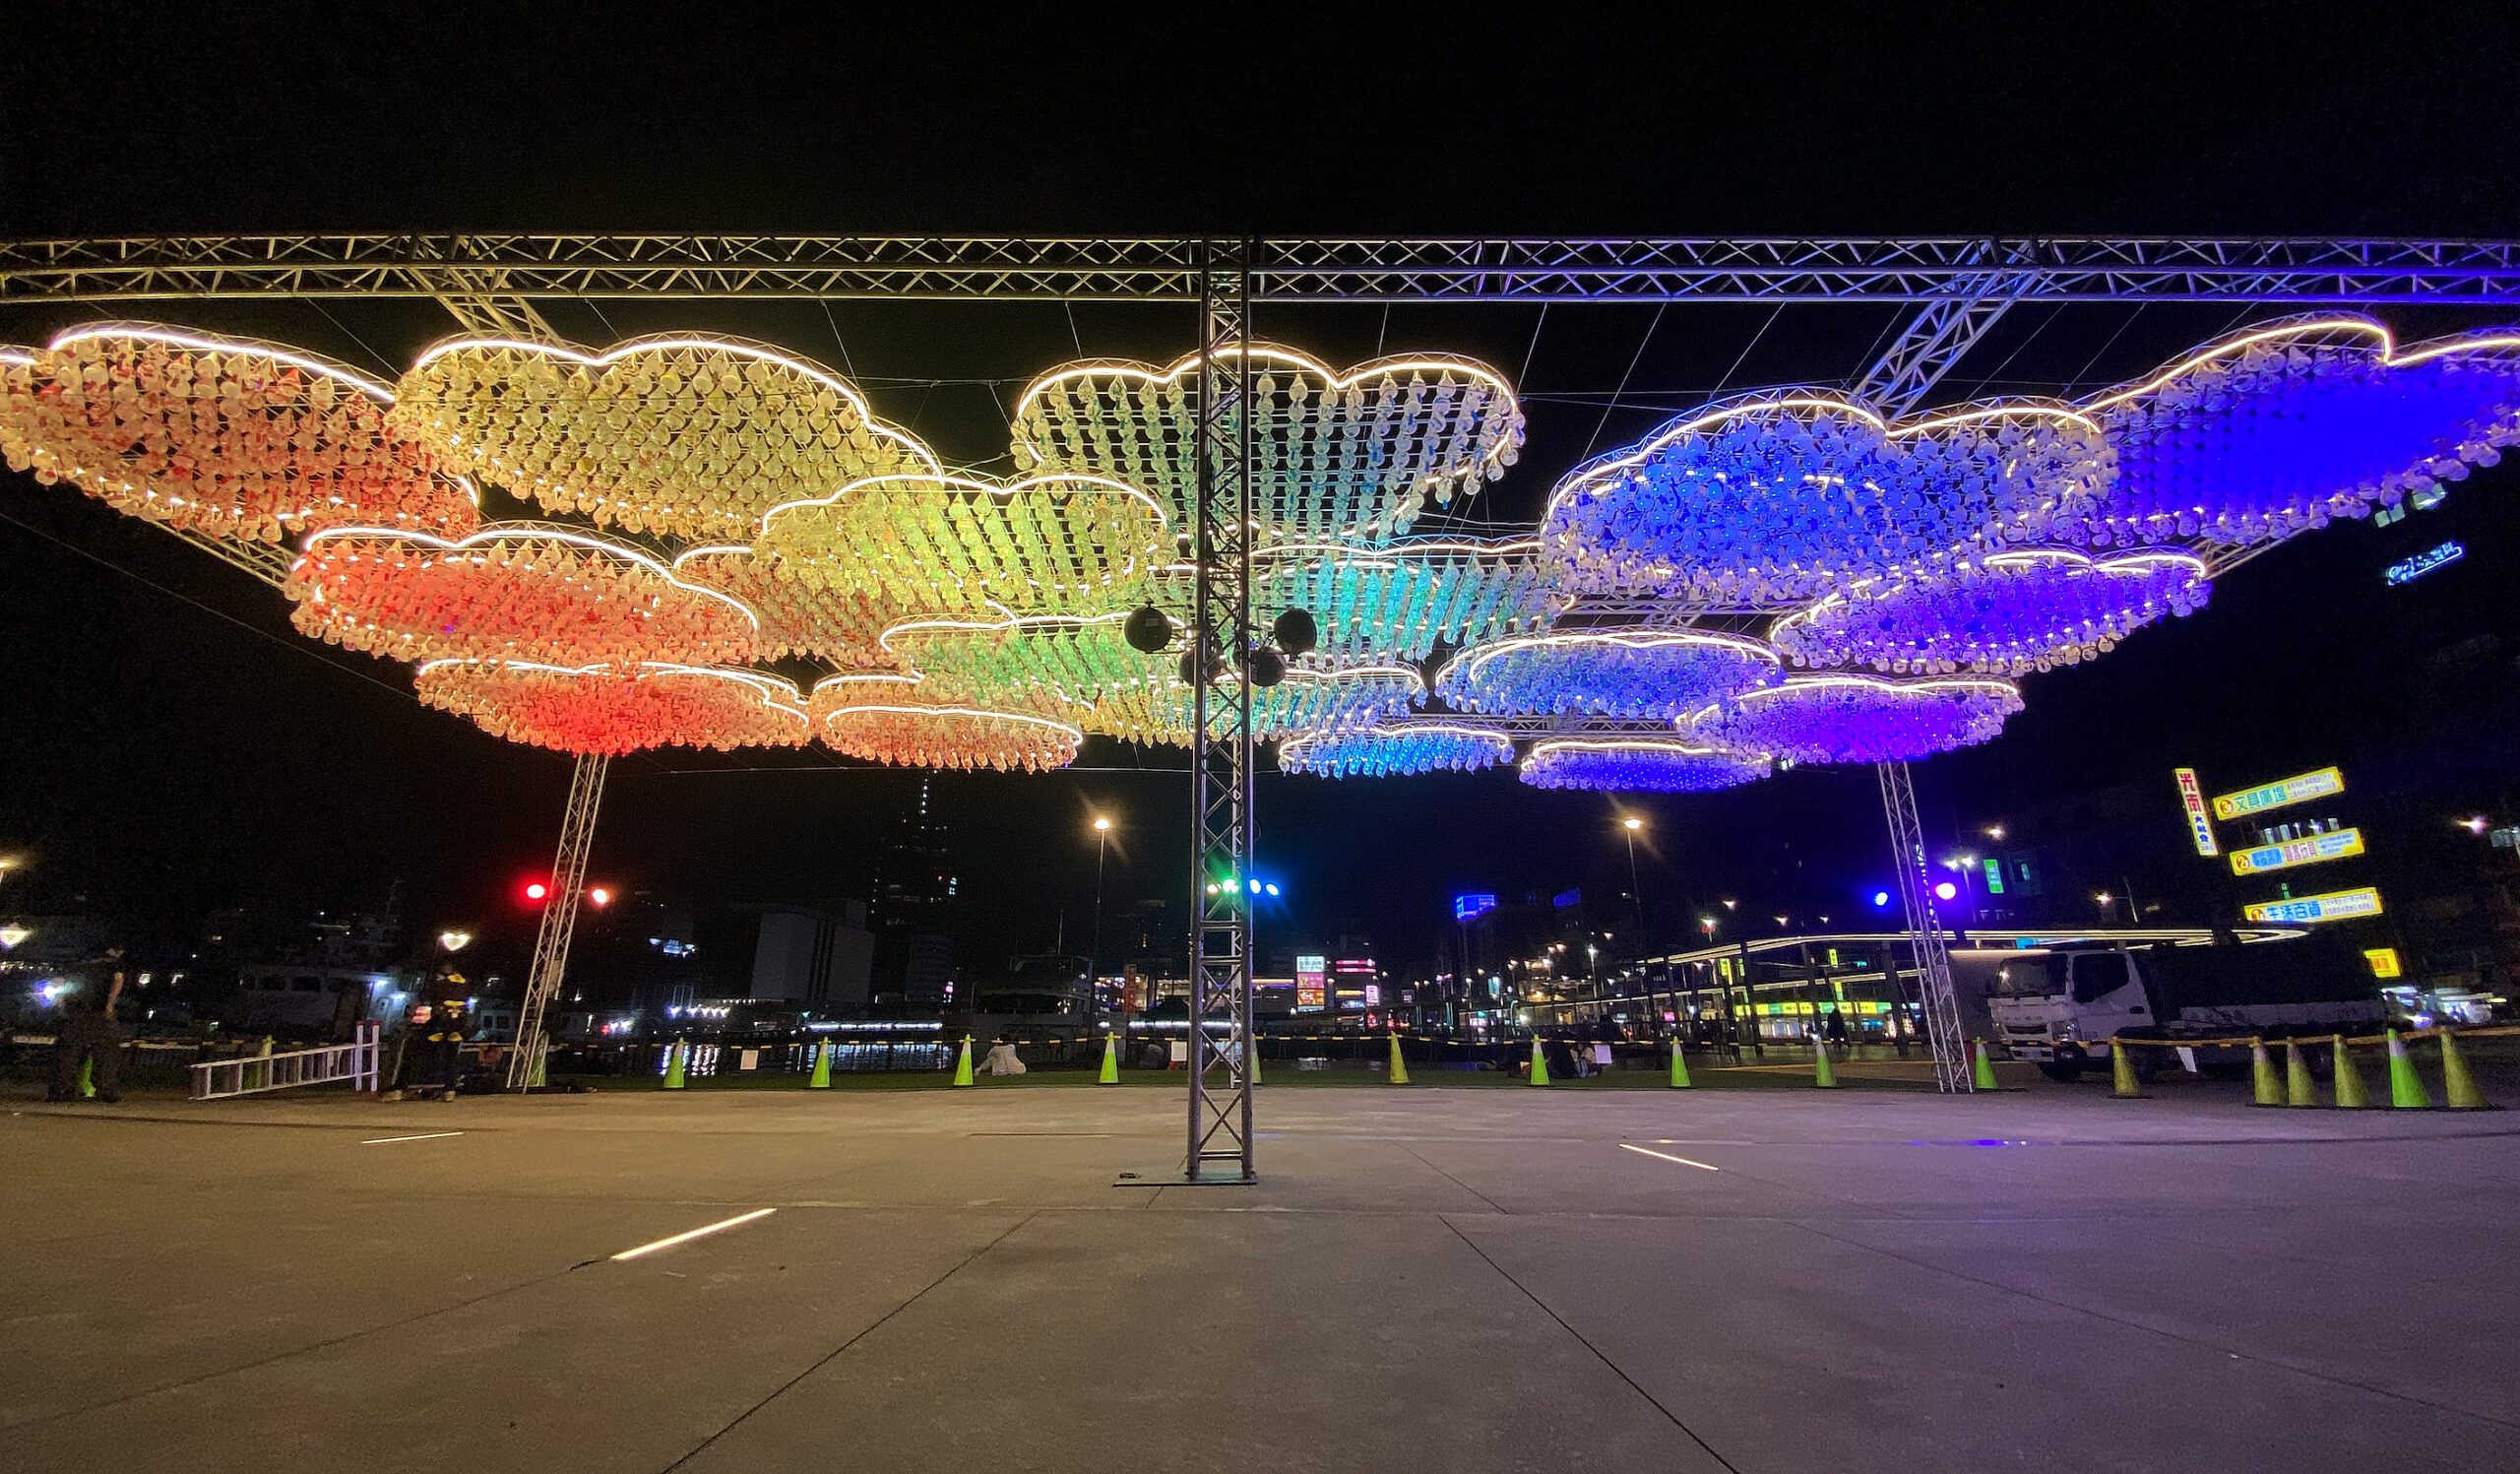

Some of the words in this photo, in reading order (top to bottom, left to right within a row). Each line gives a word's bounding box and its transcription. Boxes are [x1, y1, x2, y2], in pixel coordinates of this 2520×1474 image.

[2234, 785, 2288, 812] 文具廣場
[2266, 900, 2322, 921] 生活百貨
